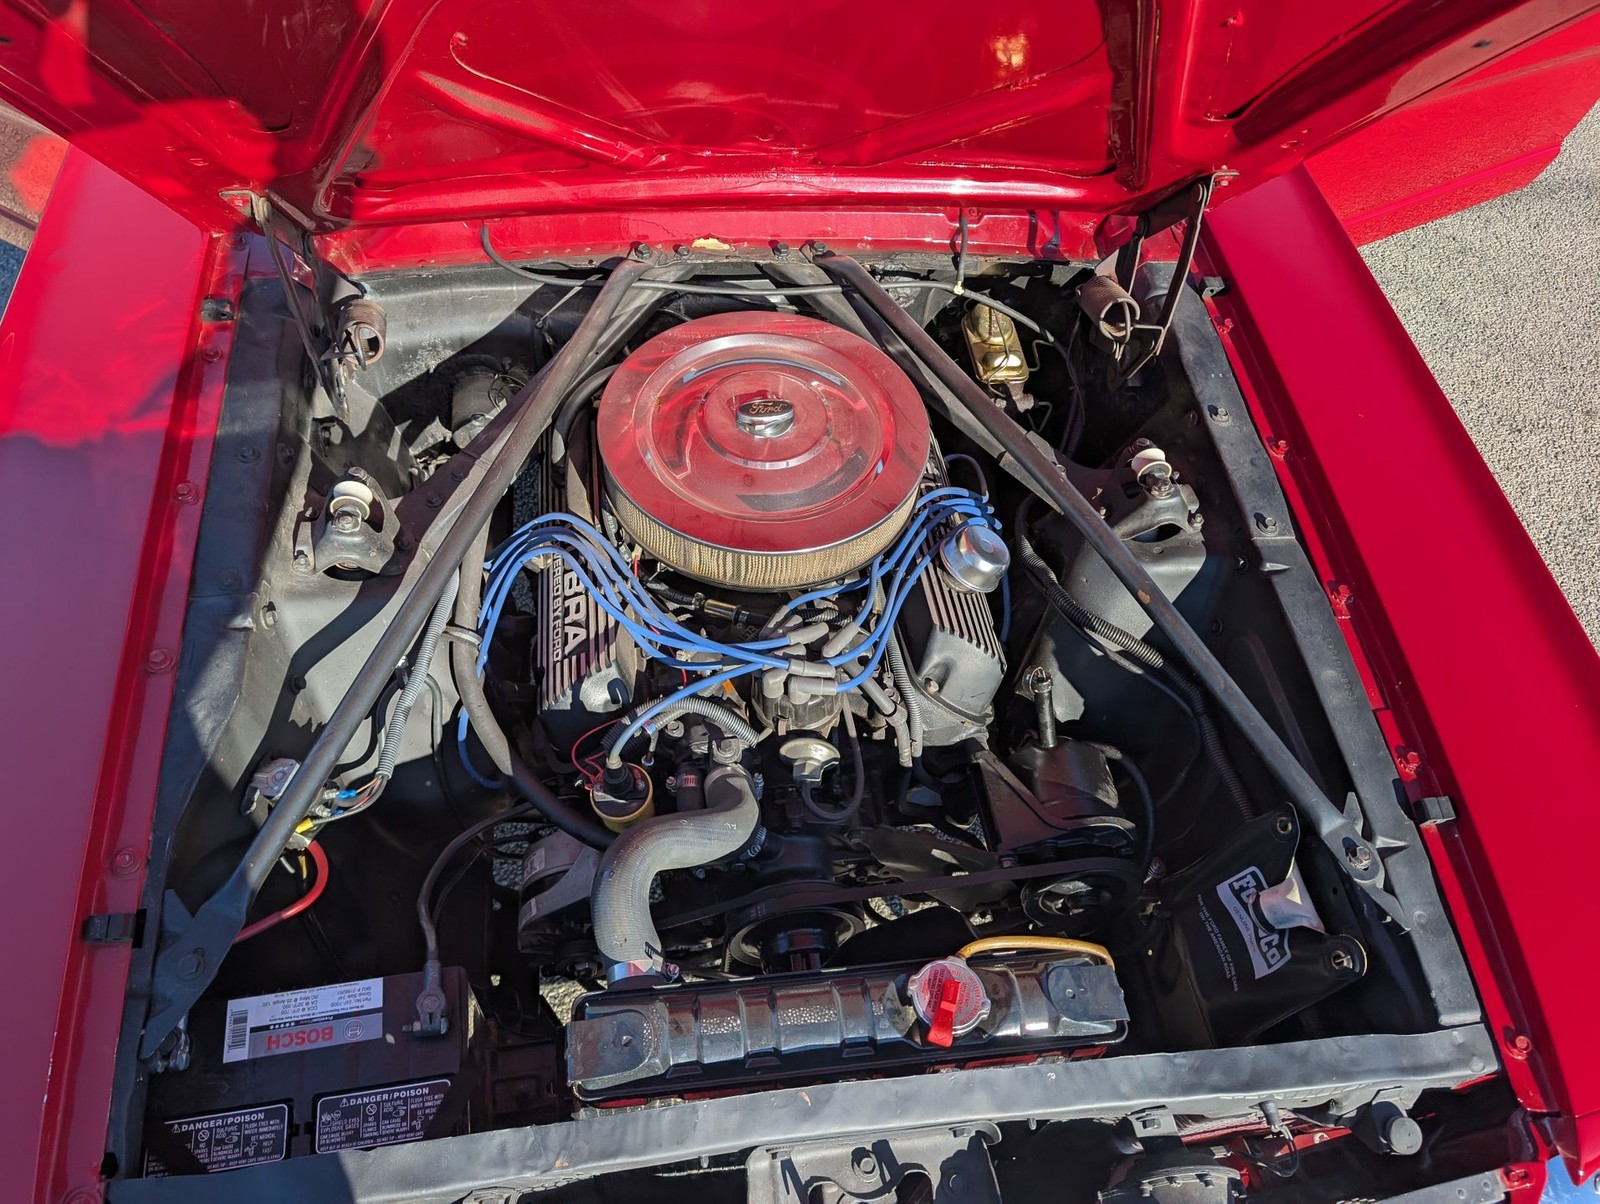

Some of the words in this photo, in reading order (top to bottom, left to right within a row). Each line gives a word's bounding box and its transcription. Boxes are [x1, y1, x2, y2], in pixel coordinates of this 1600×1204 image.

[749, 402, 783, 414] Ford
[553, 553, 562, 596] ERED
[553, 598, 562, 617] BY
[564, 571, 587, 656] BRA
[553, 619, 562, 662] FORD
[1233, 906, 1250, 934] GENUINE
[1208, 918, 1219, 934] FORD
[1218, 934, 1230, 954] FAMILY
[1210, 933, 1225, 962] AMERICAN
[1224, 963, 1232, 979] ROAD
[267, 1026, 334, 1050] BOSCH
[350, 1087, 429, 1106] DANGER/POISON
[181, 1113, 264, 1132] DANGER/POISON
